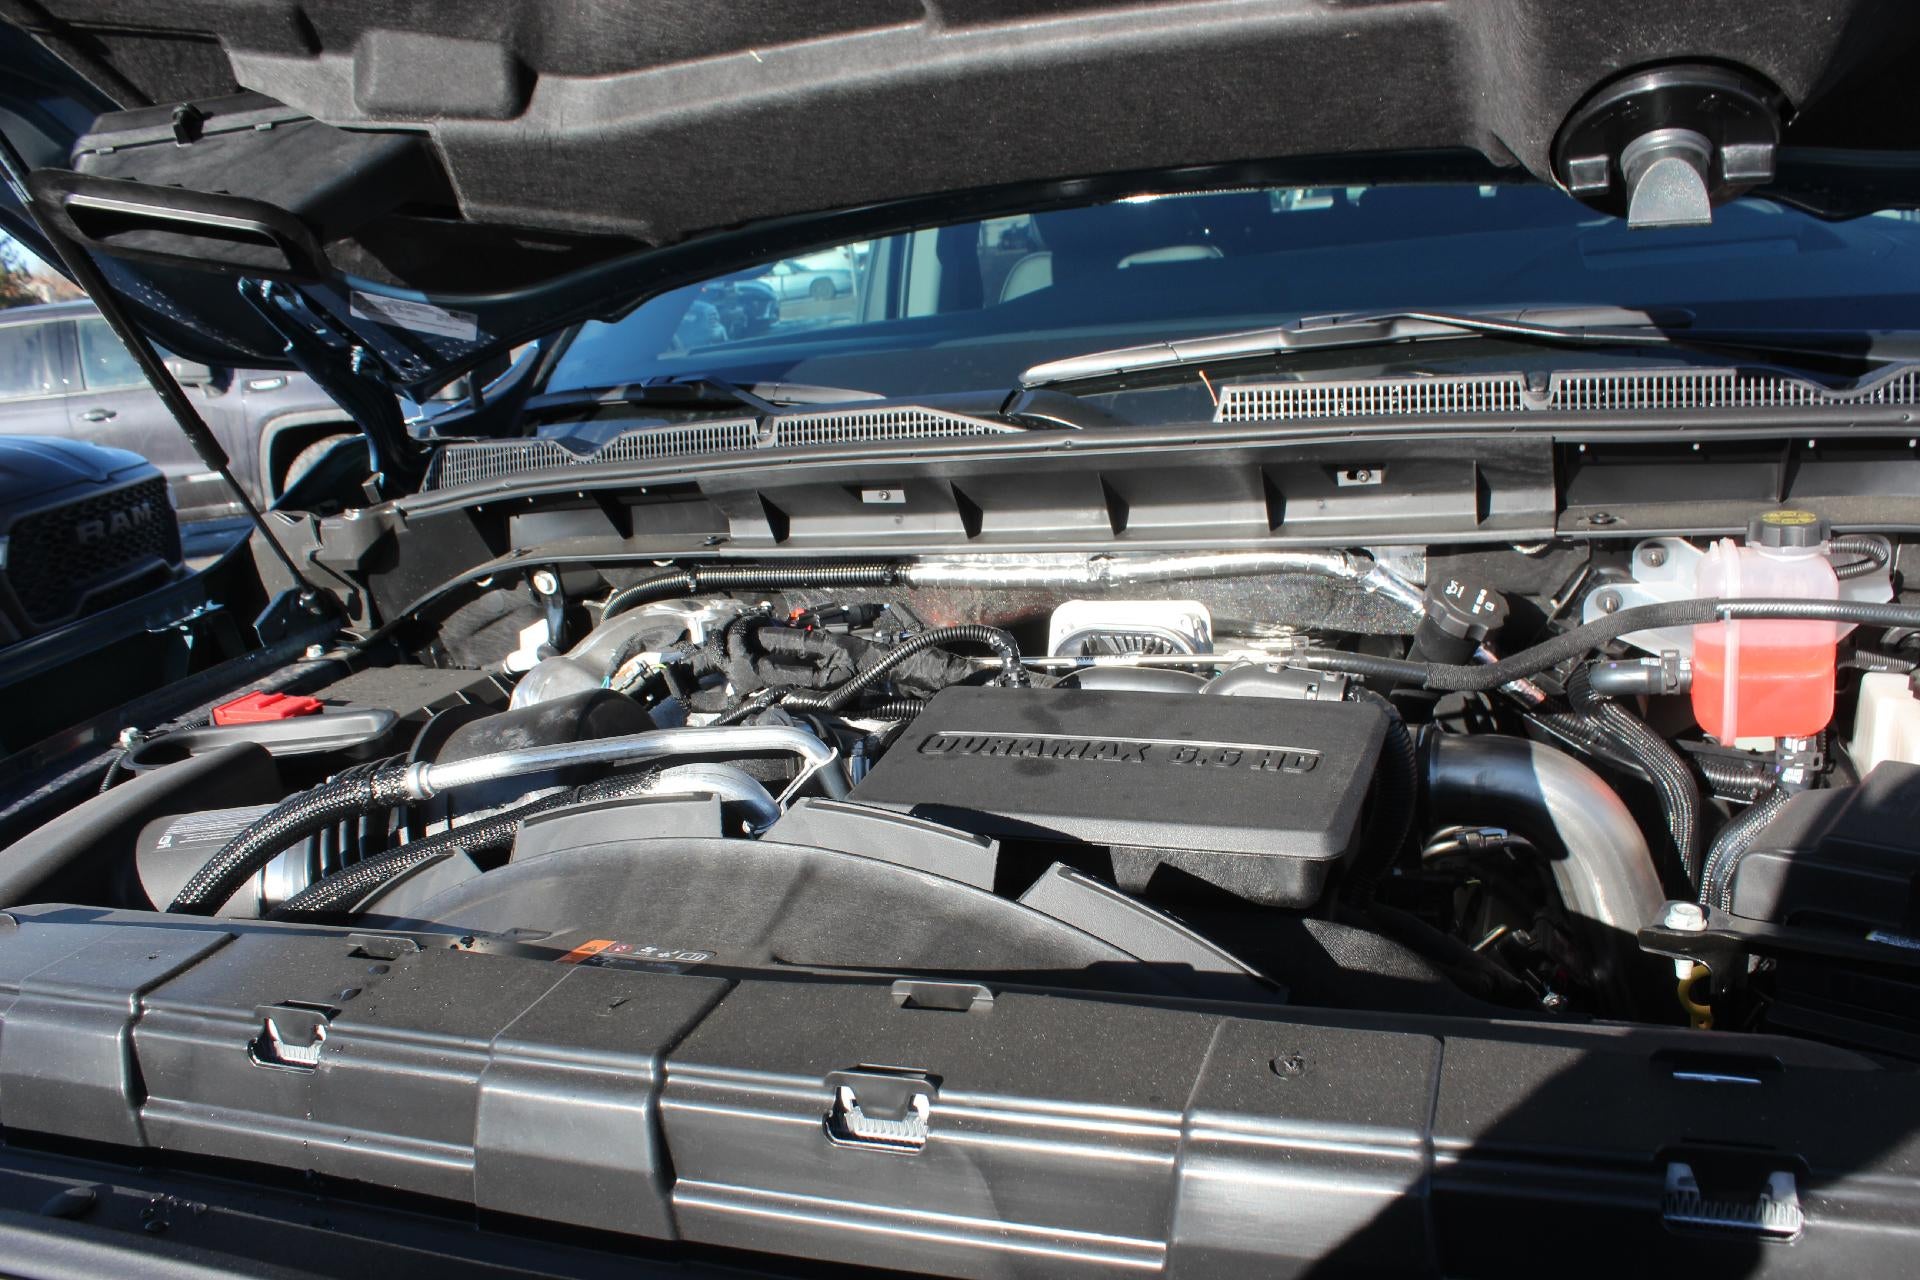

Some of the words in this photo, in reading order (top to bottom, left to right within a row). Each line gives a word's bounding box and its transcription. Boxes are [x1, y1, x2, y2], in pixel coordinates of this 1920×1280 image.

[77, 500, 151, 543] RAM
[922, 736, 1151, 762] DURAMAX
[1250, 752, 1320, 774] HD
